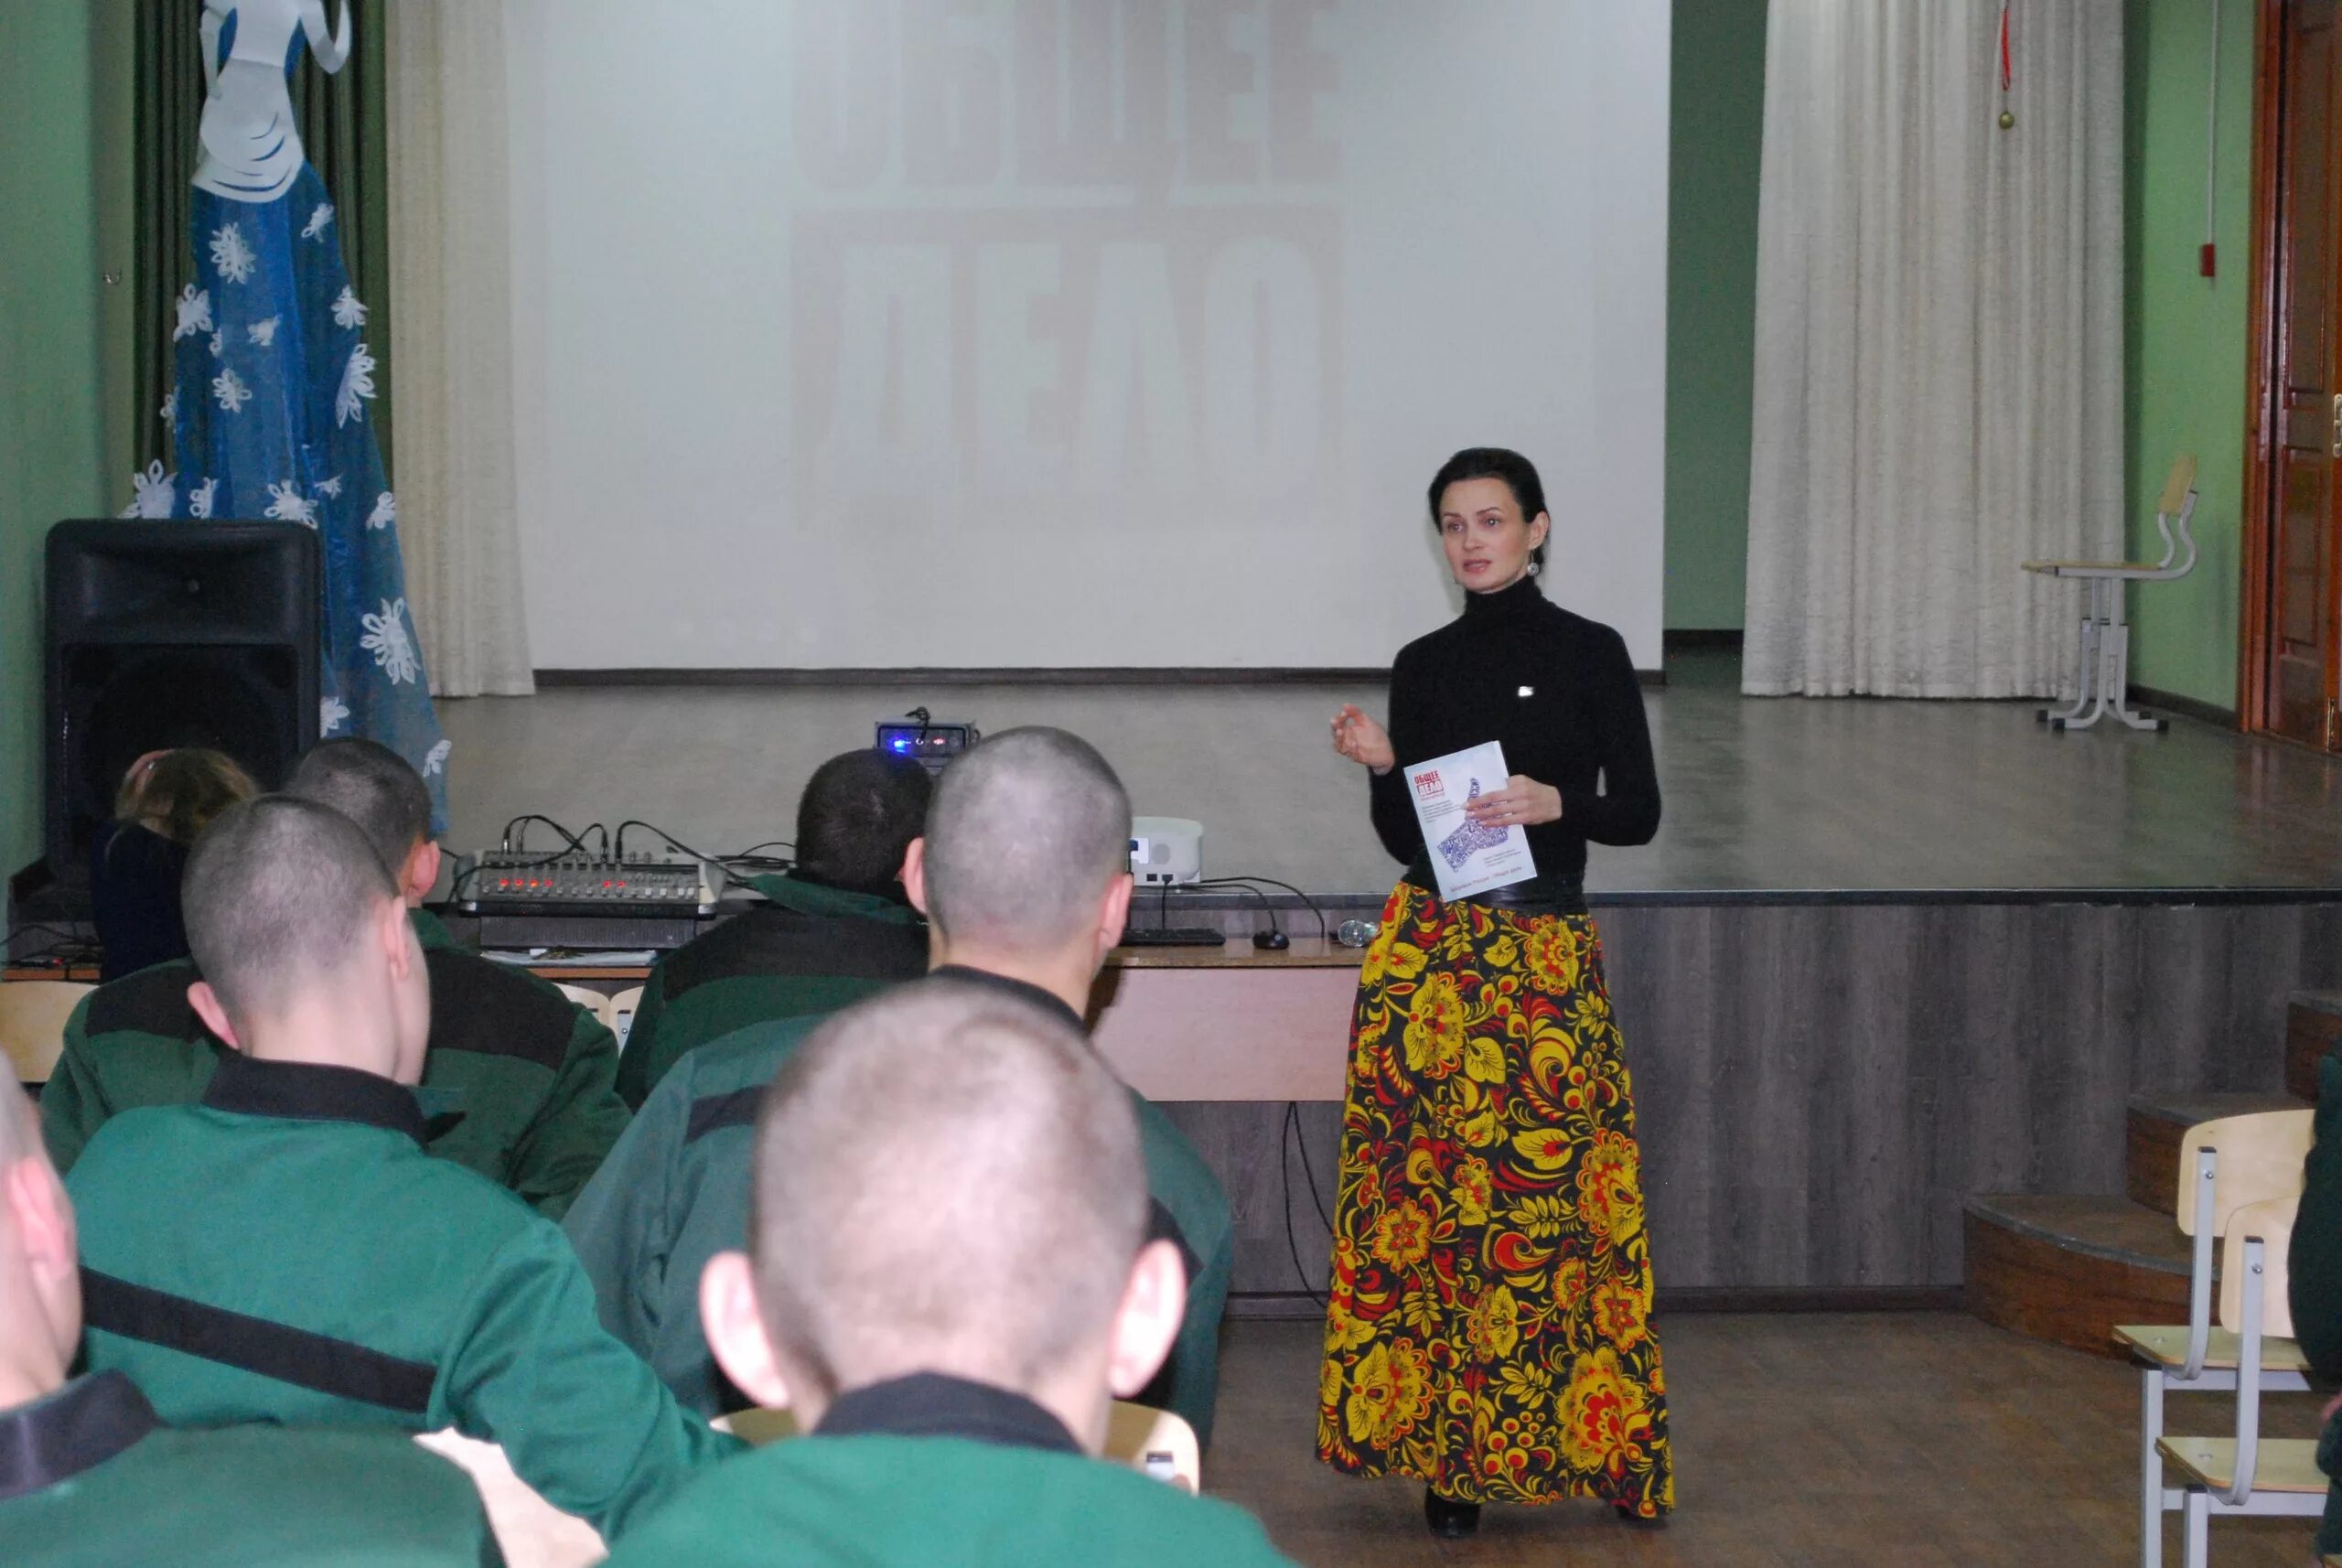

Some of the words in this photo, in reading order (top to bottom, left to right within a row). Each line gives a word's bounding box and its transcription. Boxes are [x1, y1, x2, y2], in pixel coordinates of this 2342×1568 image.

[792, 0, 1343, 205] ОБЩЕЕ
[816, 236, 1323, 518] ДЕЛО
[1414, 770, 1439, 784] ОБЩЕЕ
[1418, 780, 1443, 797] ДЕЛО
